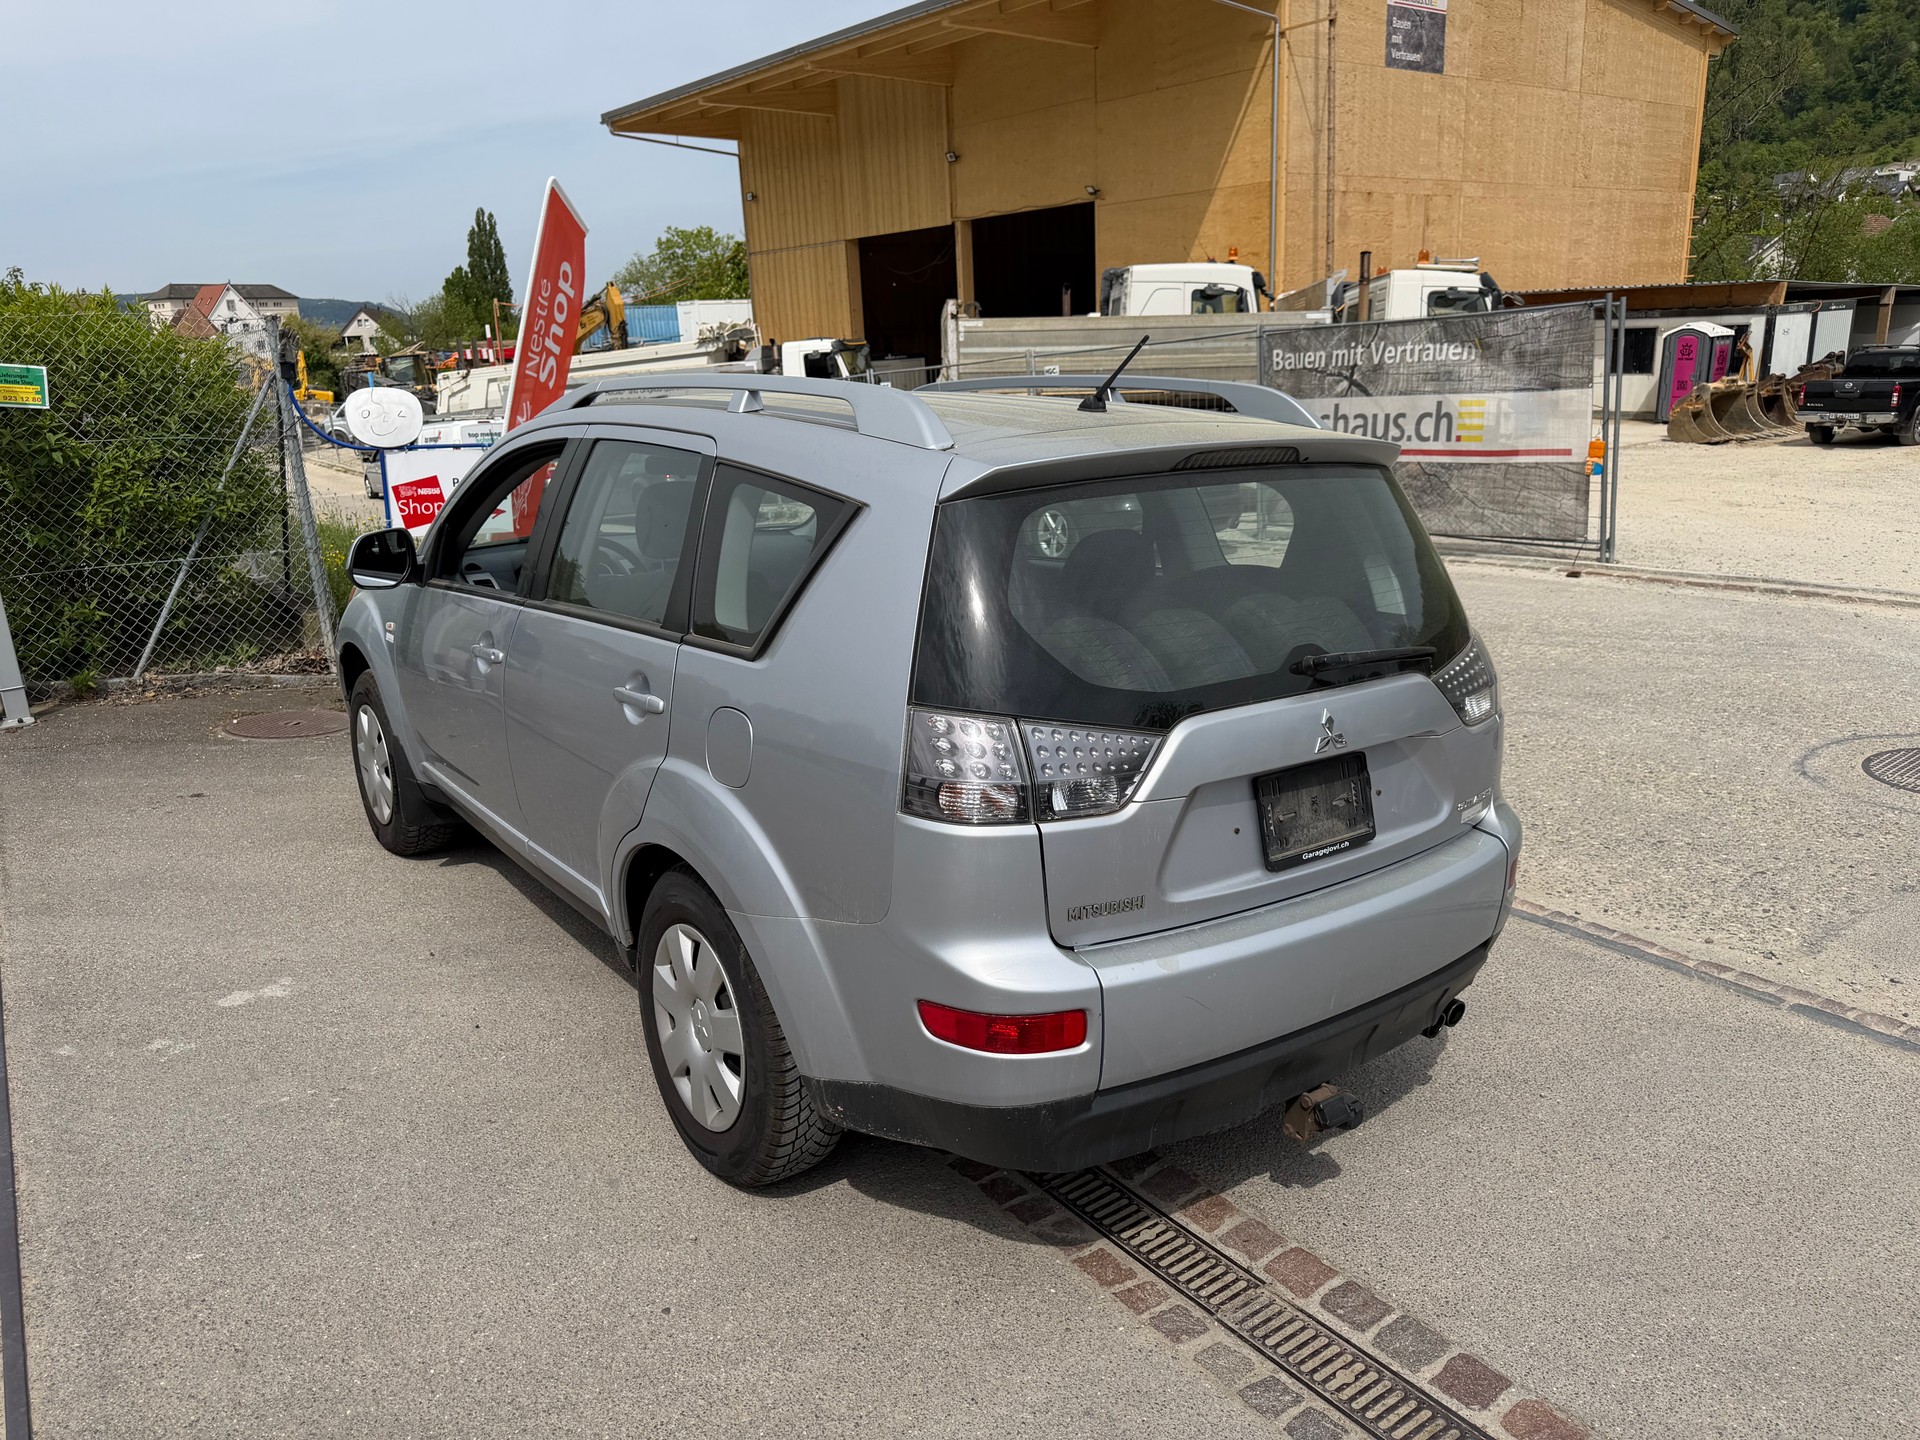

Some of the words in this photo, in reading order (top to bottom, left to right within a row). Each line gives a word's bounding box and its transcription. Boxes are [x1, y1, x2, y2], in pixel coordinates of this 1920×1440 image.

[1392, 17, 1411, 30] Bauen
[1391, 33, 1402, 44] mit
[539, 261, 575, 389] Shop
[1272, 349, 1326, 371] Bauen
[1332, 341, 1364, 366] mit
[1320, 401, 1453, 443] haus.ch
[1302, 841, 1350, 860] Garagejovi.ch
[1067, 895, 1146, 922] MITSUBISHI
